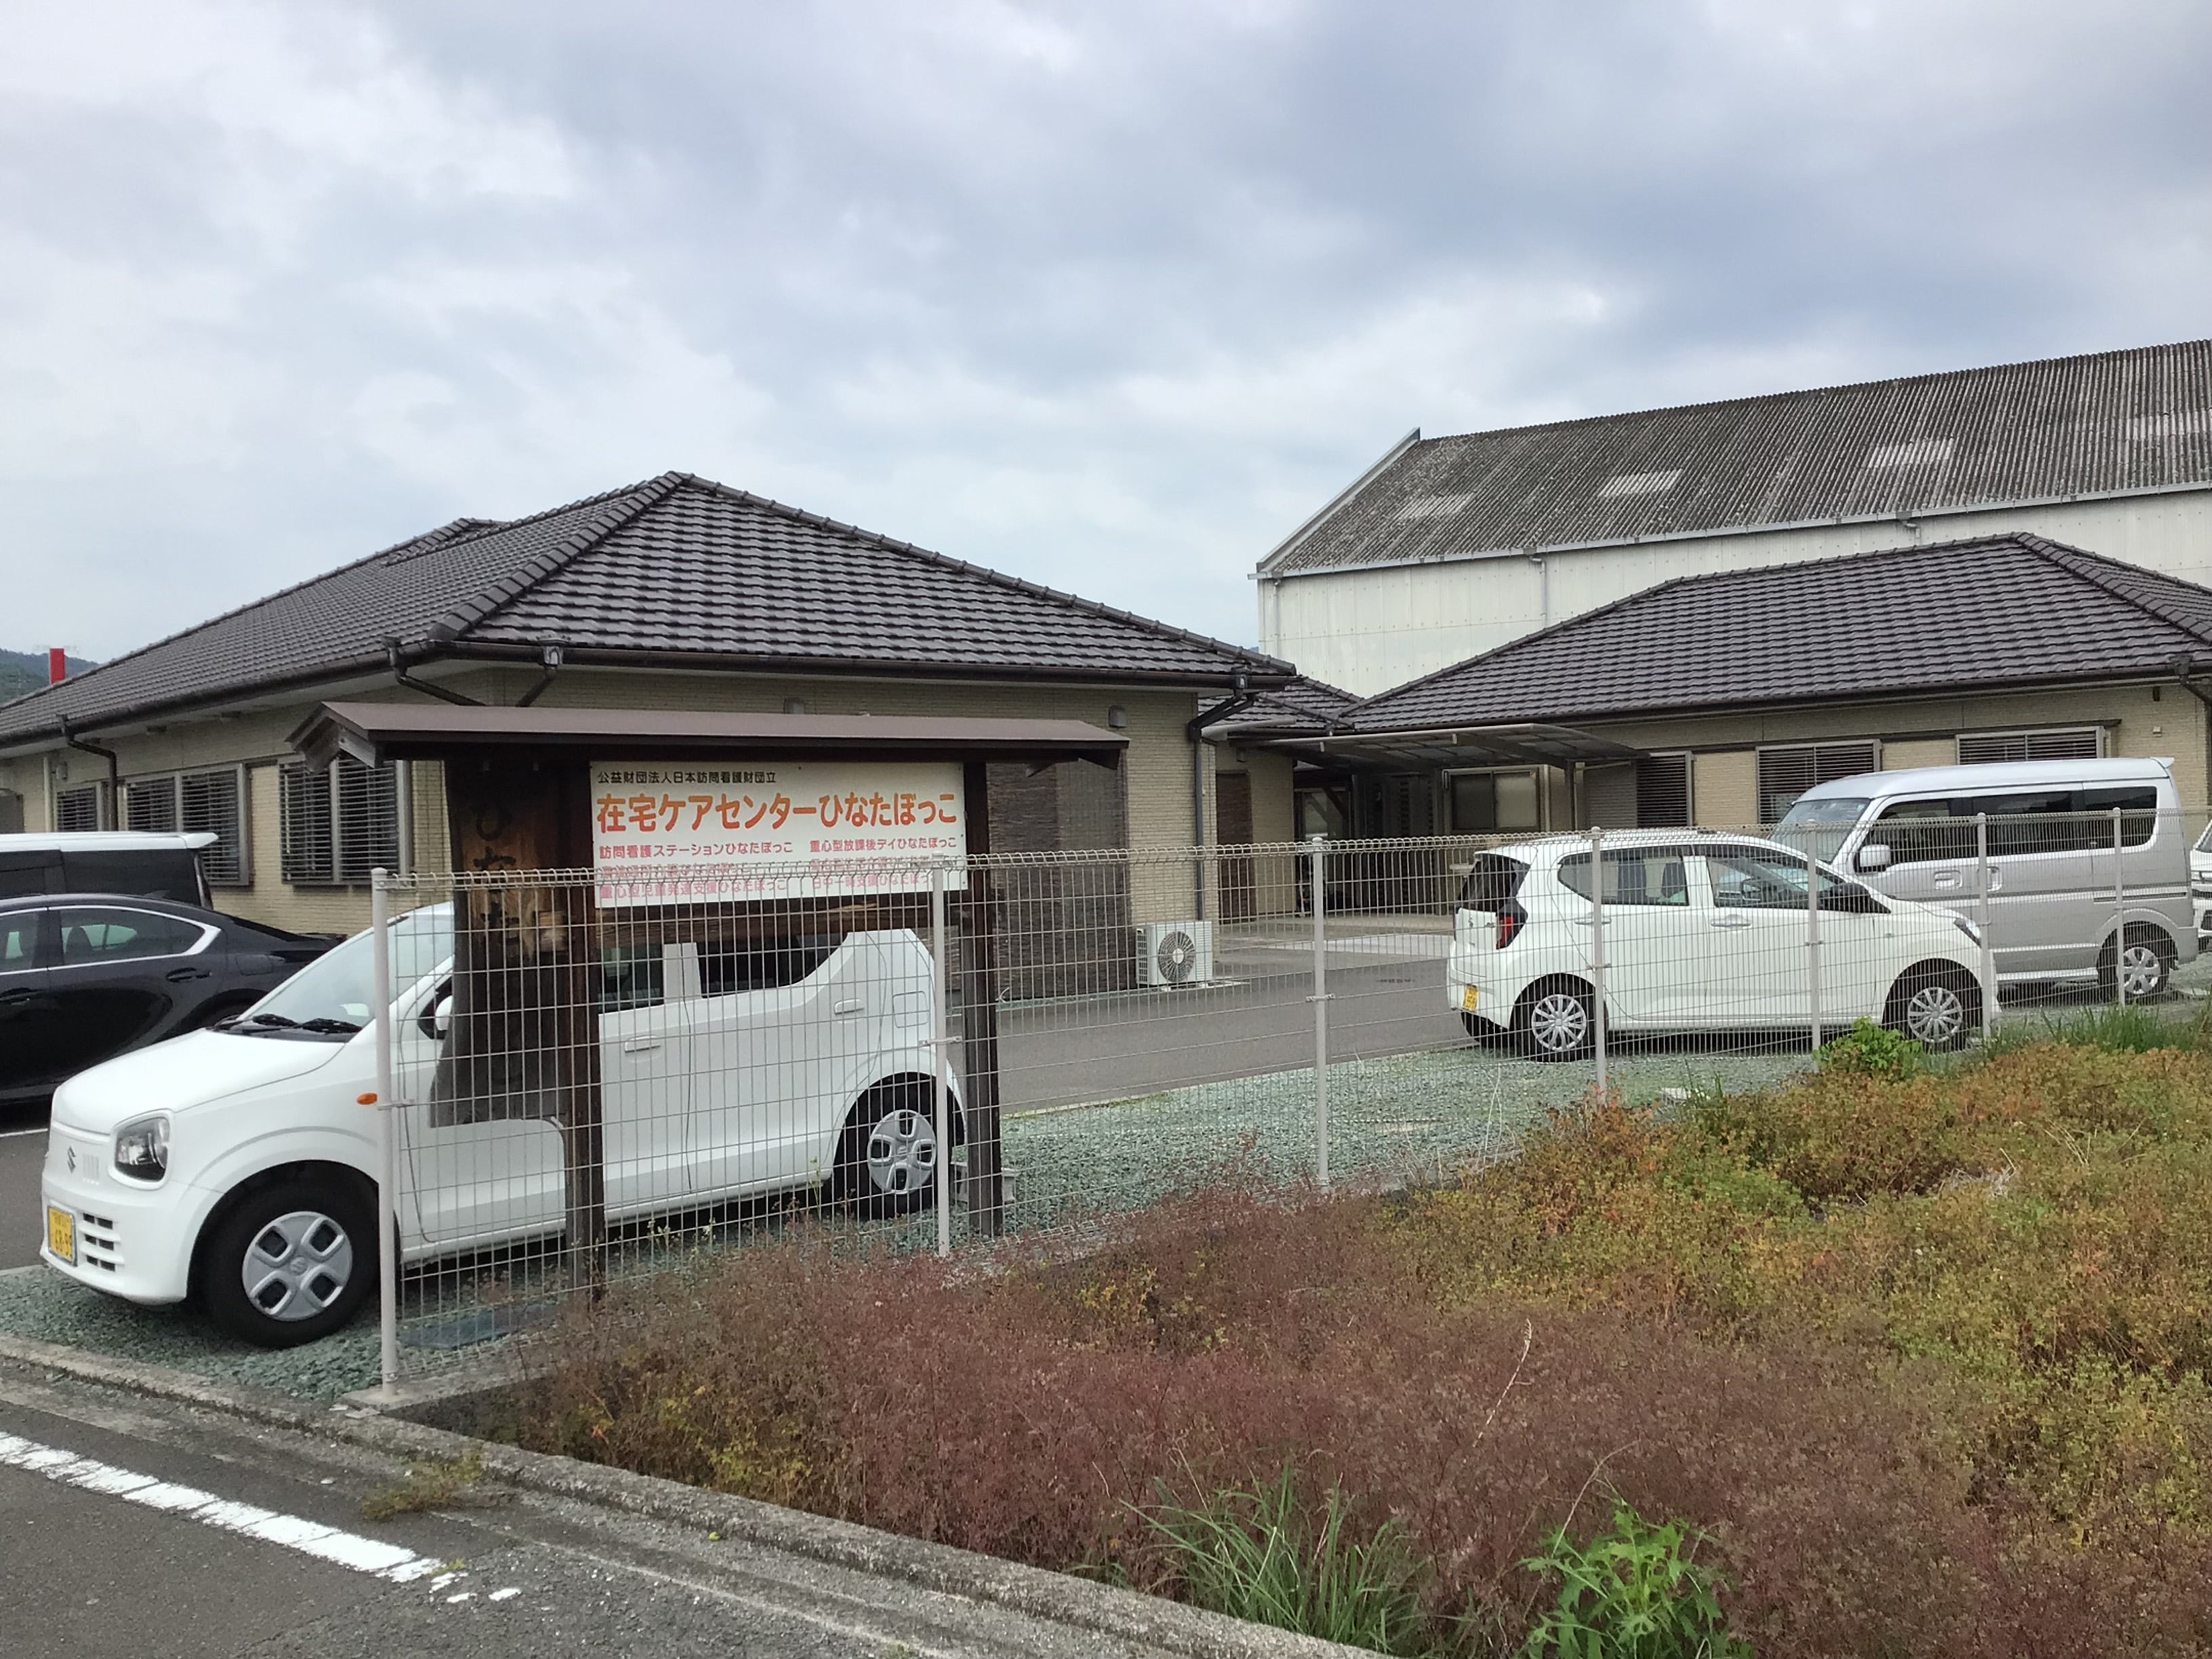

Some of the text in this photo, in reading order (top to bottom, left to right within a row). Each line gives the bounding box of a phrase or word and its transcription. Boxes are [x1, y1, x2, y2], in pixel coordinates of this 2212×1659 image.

[597, 771, 777, 784] 公益財団法人日本訪問看護財団立
[596, 792, 958, 834] 在宅ケアセンターひなたぼっこ
[599, 842, 794, 859] 訪問看護ステーションひなたぼっこ
[810, 837, 957, 853] 重心型放課後デイひなたぼっこ
